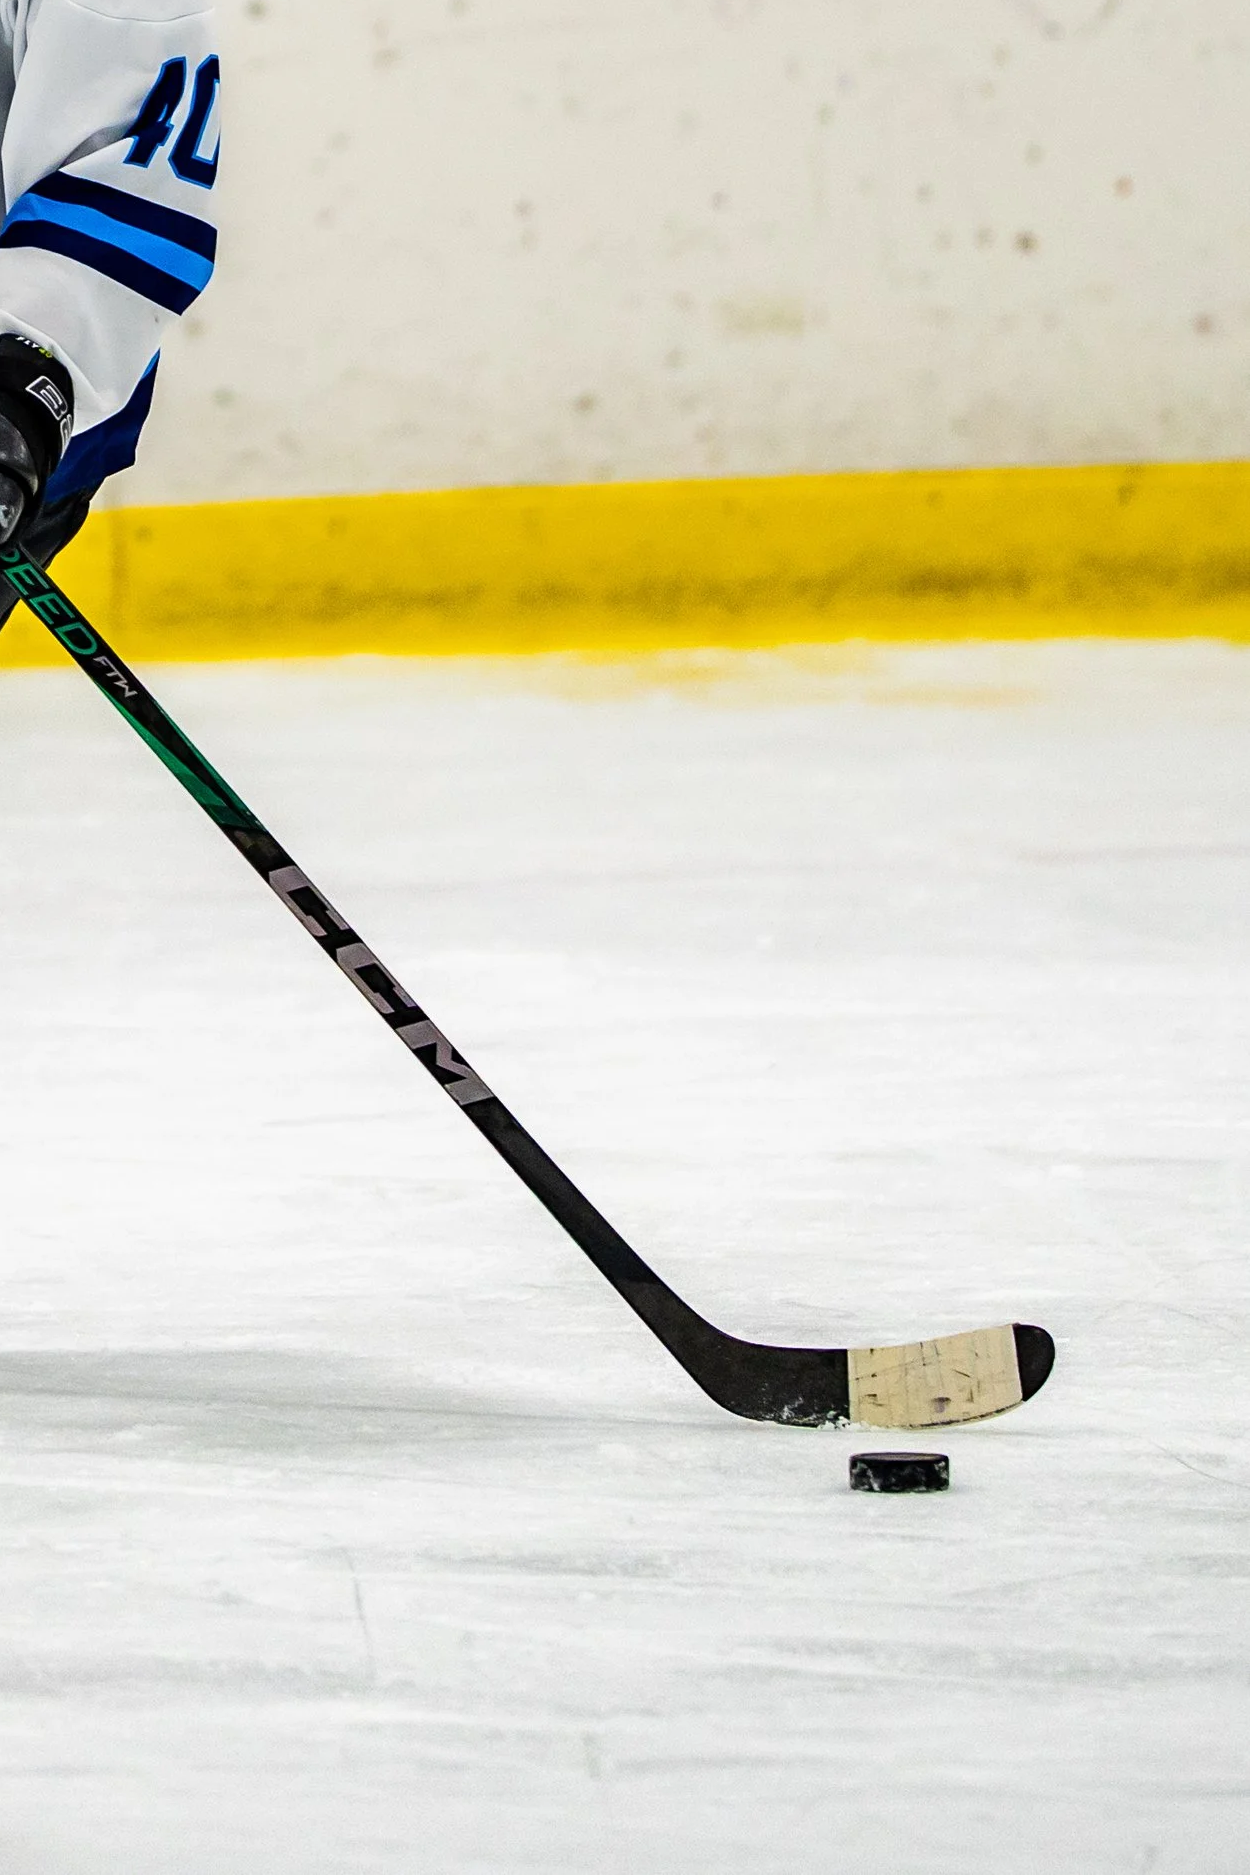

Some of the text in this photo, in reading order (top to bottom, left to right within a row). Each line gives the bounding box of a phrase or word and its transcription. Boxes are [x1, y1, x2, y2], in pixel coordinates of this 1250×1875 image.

[122, 53, 221, 190] 40
[92, 655, 138, 698] FTW
[268, 864, 495, 1096] CCM
